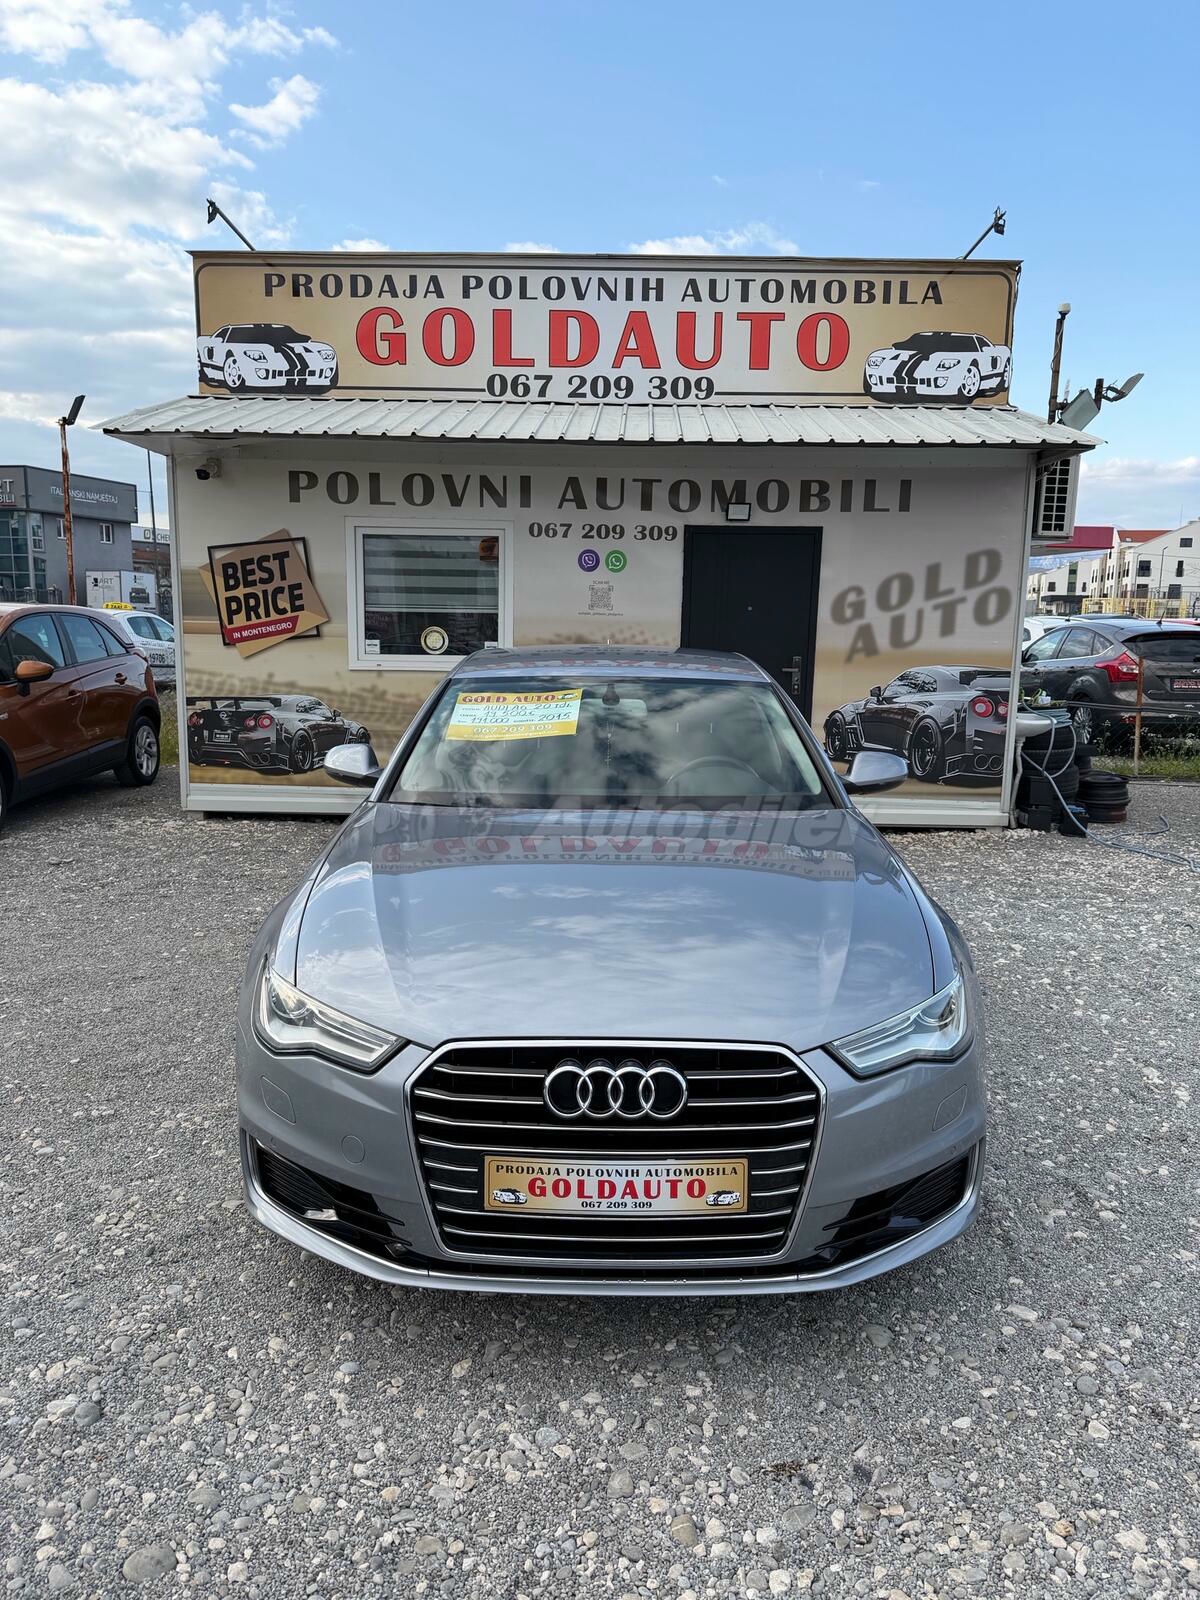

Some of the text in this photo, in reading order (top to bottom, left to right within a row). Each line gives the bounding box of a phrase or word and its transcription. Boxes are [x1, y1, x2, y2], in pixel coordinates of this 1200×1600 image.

[264, 272, 944, 305] PRODAJA POLOVNIH AUTOMOBILA
[355, 307, 851, 372] GOLDAUTO
[486, 373, 715, 401] 067 209 309
[288, 470, 913, 513] POLOVNI AUTOMOBILI
[528, 521, 678, 542] 067 209 309
[221, 550, 290, 592] BEST
[829, 548, 1003, 627] GOLD
[225, 582, 305, 626] PRICE
[232, 621, 293, 639] IN MONTENEGRO
[845, 585, 1013, 665] AUTO
[462, 694, 556, 703] GOLD AUTO
[495, 1164, 739, 1178] PRODAJA POLOVNIH AUTOMOBILA
[527, 1177, 707, 1200] GOLDAUTO
[580, 1200, 653, 1210] 067 209 309
